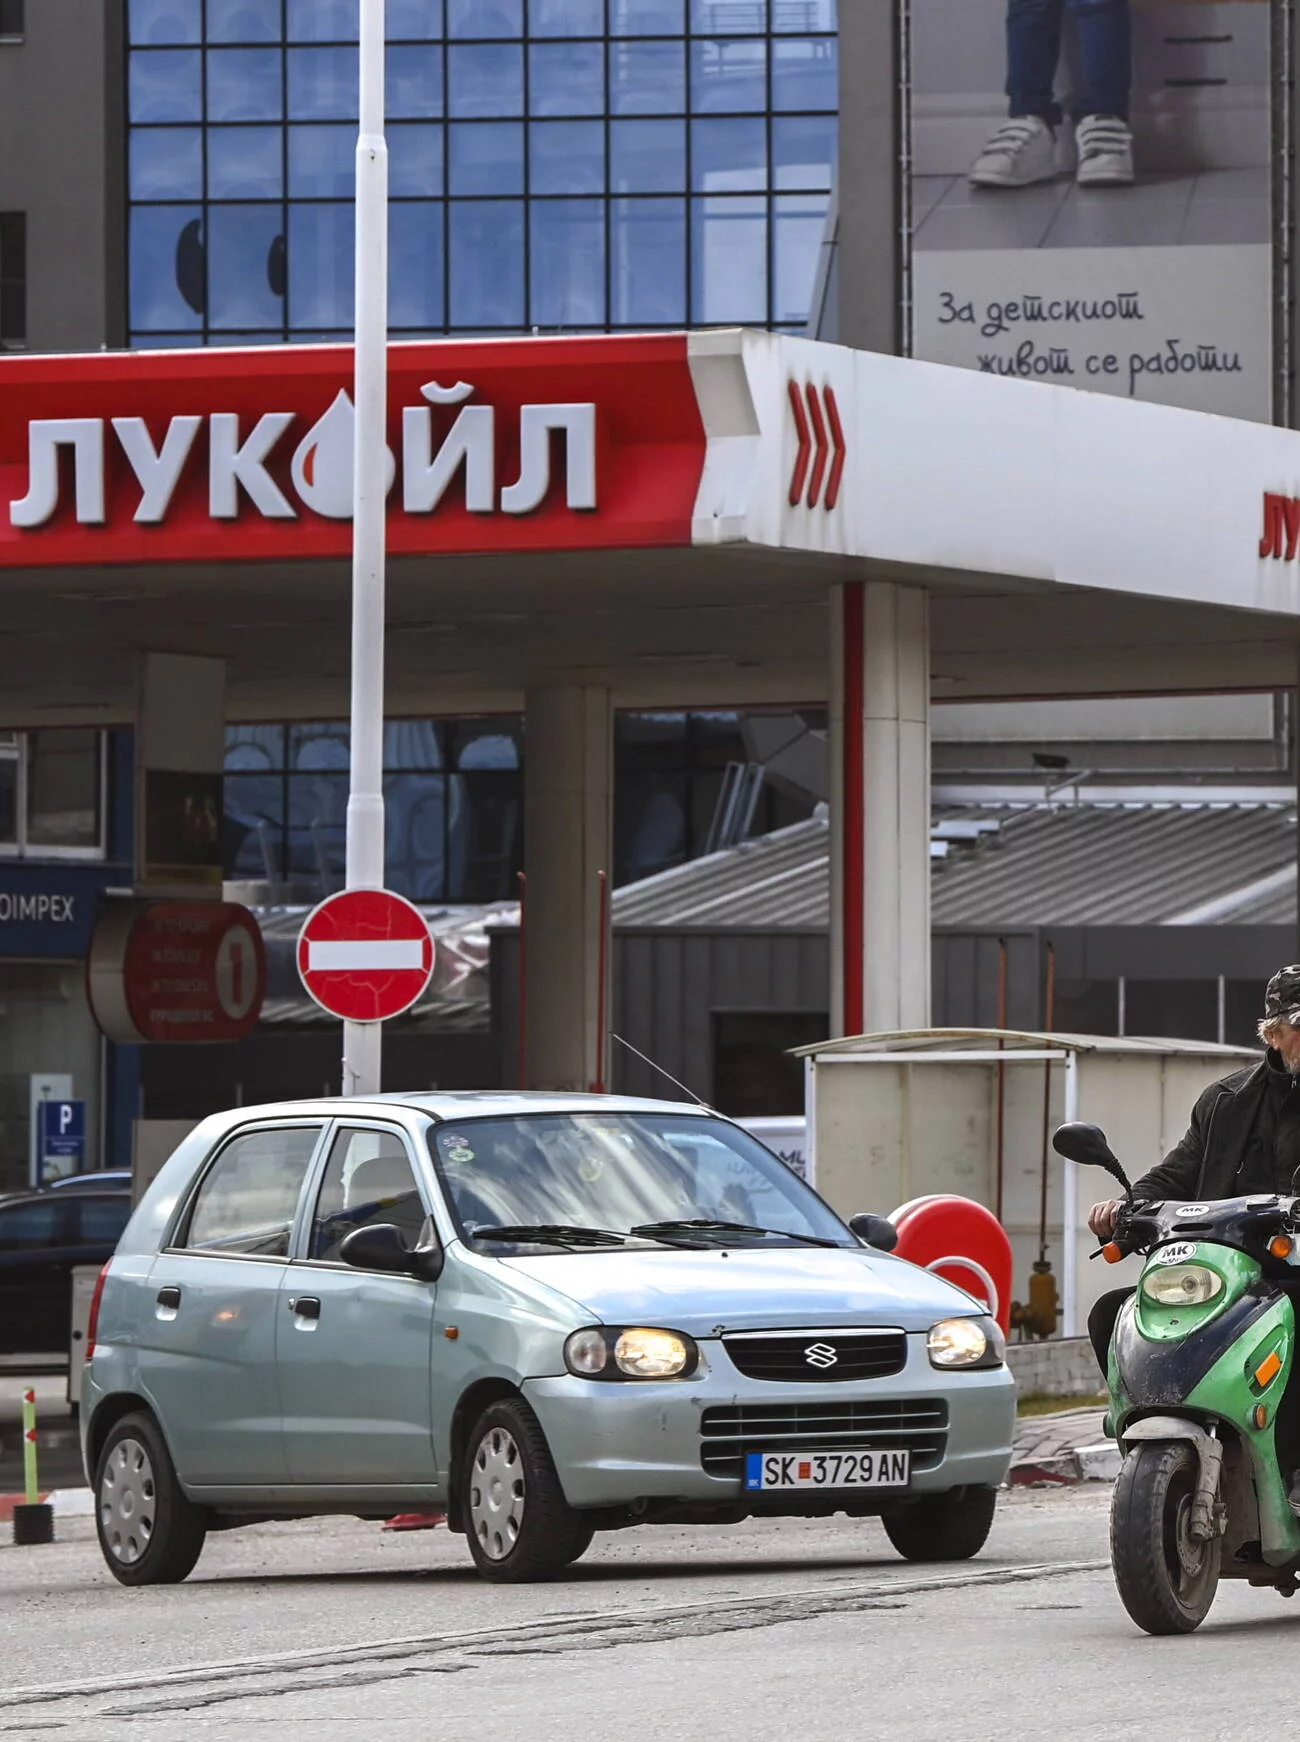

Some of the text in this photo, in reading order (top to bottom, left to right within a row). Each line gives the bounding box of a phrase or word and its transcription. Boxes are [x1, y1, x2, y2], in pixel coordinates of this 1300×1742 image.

[937, 291, 1145, 337] За детскиот
[977, 338, 1243, 396] живот се работи
[9, 381, 596, 527] ЛУКОЙЛ
[60, 1104, 73, 1135] P
[1161, 1245, 1189, 1258] MK
[764, 1453, 906, 1486] SK 3729 AN
